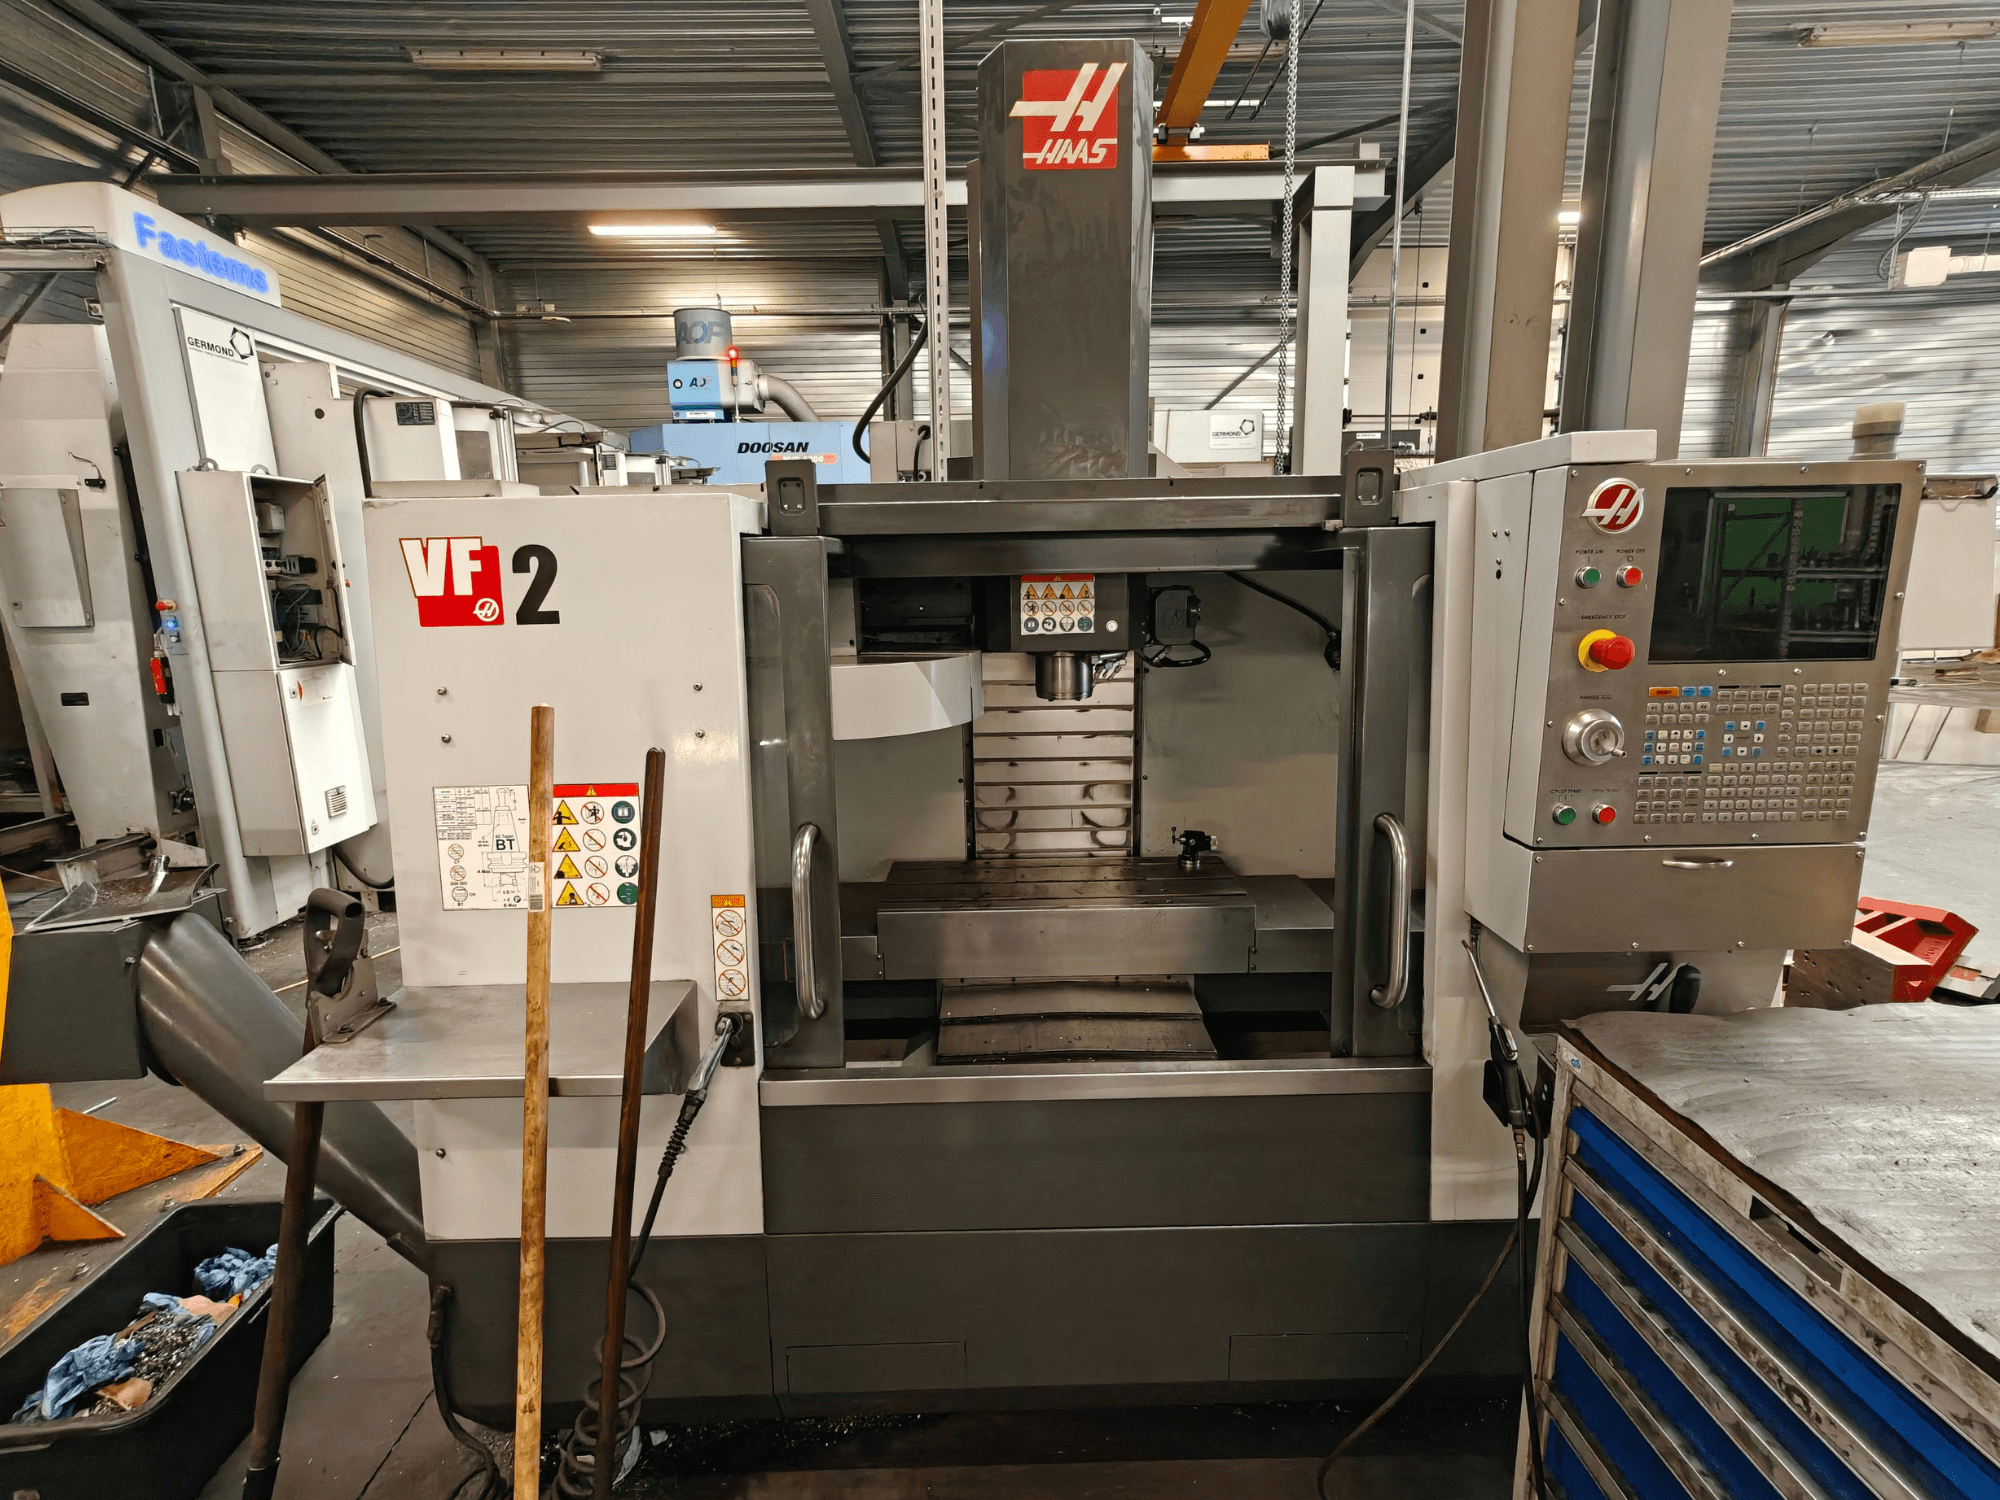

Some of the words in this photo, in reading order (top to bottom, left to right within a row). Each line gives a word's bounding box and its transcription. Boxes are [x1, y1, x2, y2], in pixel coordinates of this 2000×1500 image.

[1023, 138, 1118, 164] HAAS
[133, 211, 269, 294] Fastems
[187, 336, 235, 357] GERMOND
[737, 441, 809, 454] DOOSAN
[398, 536, 483, 599] VF
[512, 544, 560, 625] 2
[496, 839, 516, 851] BT
